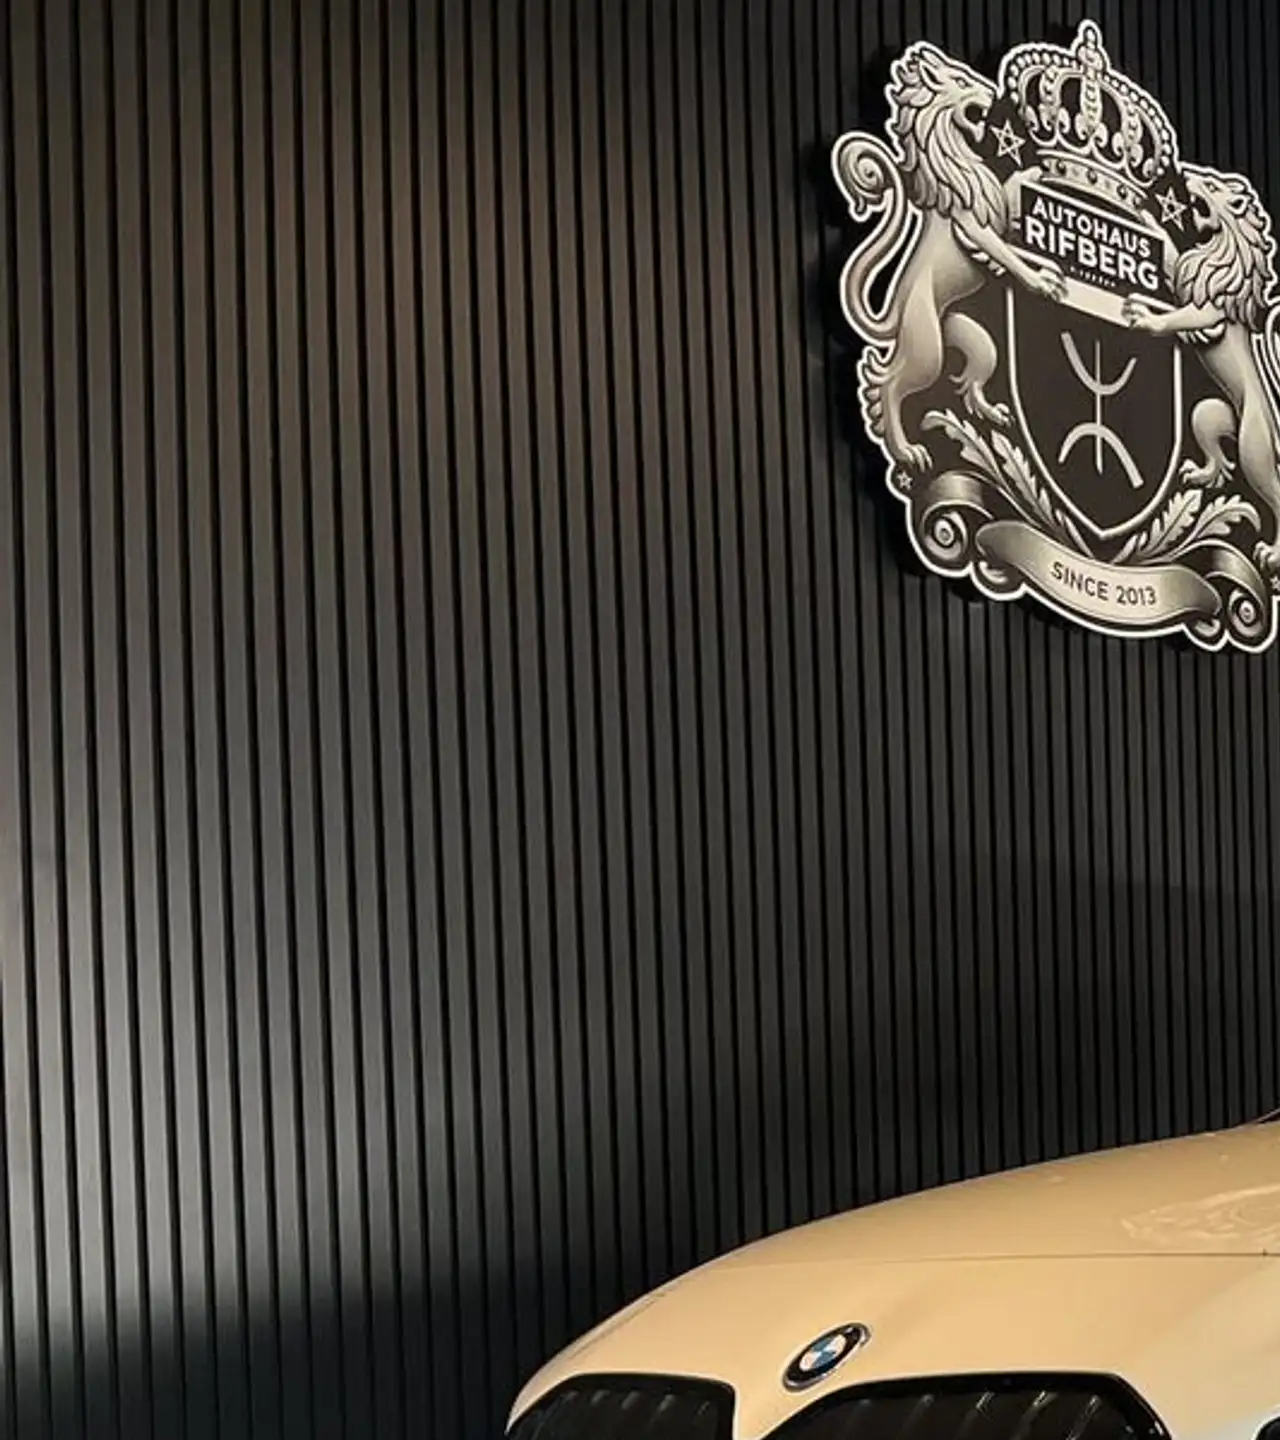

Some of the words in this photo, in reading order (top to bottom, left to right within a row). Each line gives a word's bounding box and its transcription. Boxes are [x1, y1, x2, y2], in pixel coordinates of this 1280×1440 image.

[1024, 214, 1159, 291] RIFBERG
[1032, 196, 1151, 258] AUTOHAUS
[1050, 560, 1109, 602] SINCE
[1115, 584, 1157, 606] 2013
